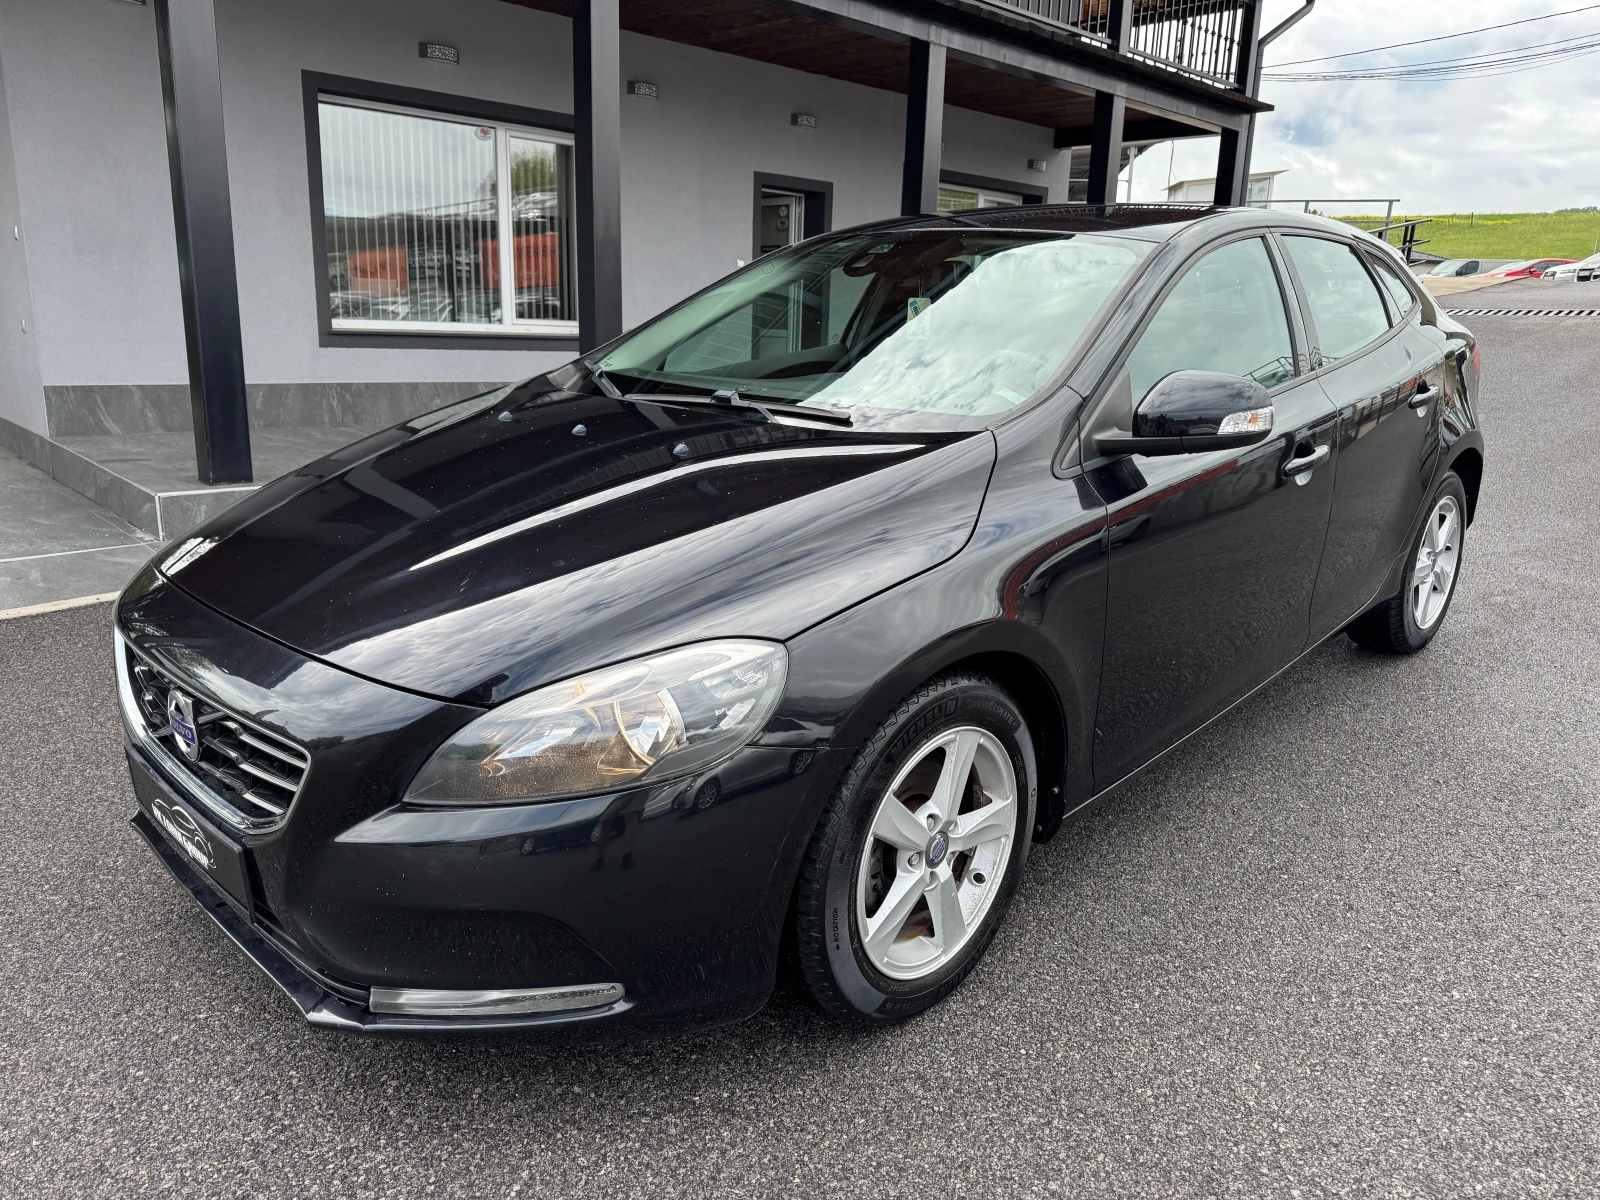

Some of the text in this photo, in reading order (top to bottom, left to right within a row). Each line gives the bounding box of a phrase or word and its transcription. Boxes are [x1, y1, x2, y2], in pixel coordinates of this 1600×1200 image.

[172, 718, 192, 739] VOLVO
[889, 700, 958, 762] MICHELIN
[832, 907, 840, 943] ROTATION
